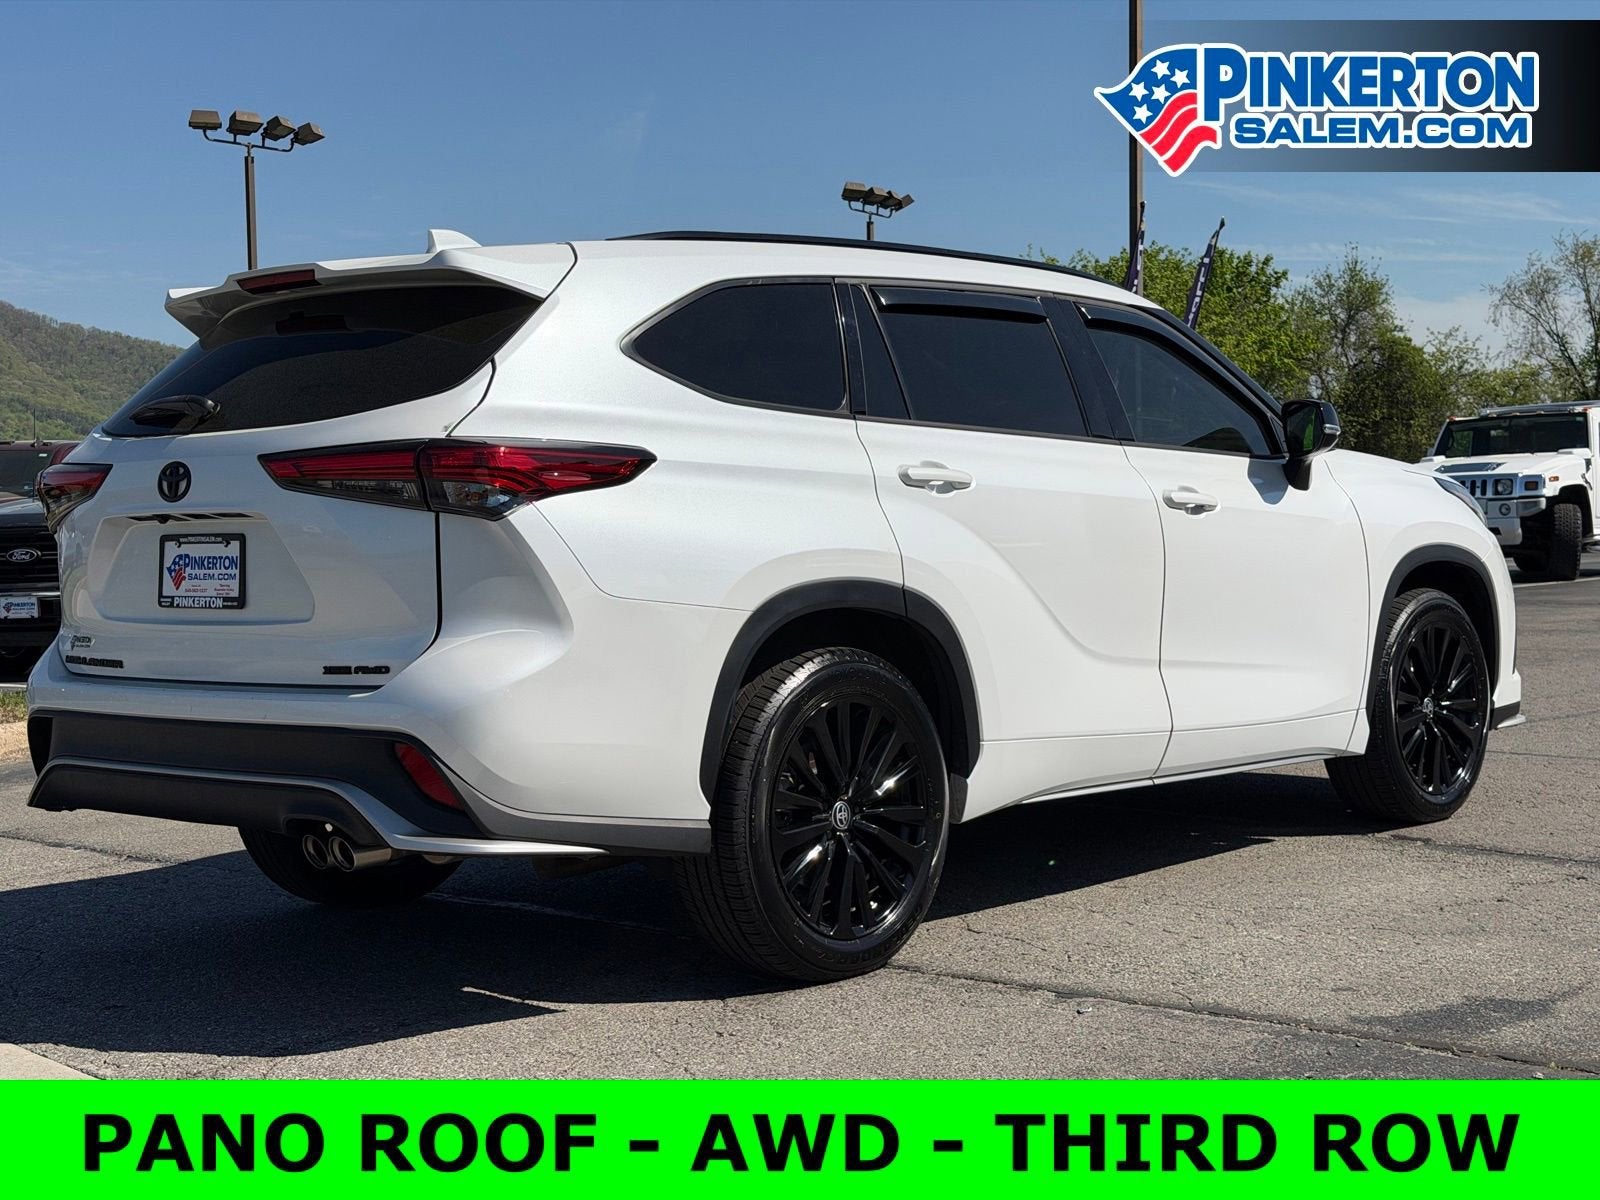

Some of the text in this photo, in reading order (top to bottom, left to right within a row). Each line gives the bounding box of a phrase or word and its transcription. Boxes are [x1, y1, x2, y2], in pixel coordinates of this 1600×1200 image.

[183, 554, 238, 574] PINKERTON
[187, 573, 237, 581] SALEM.COM
[173, 597, 223, 608] PINKERTON
